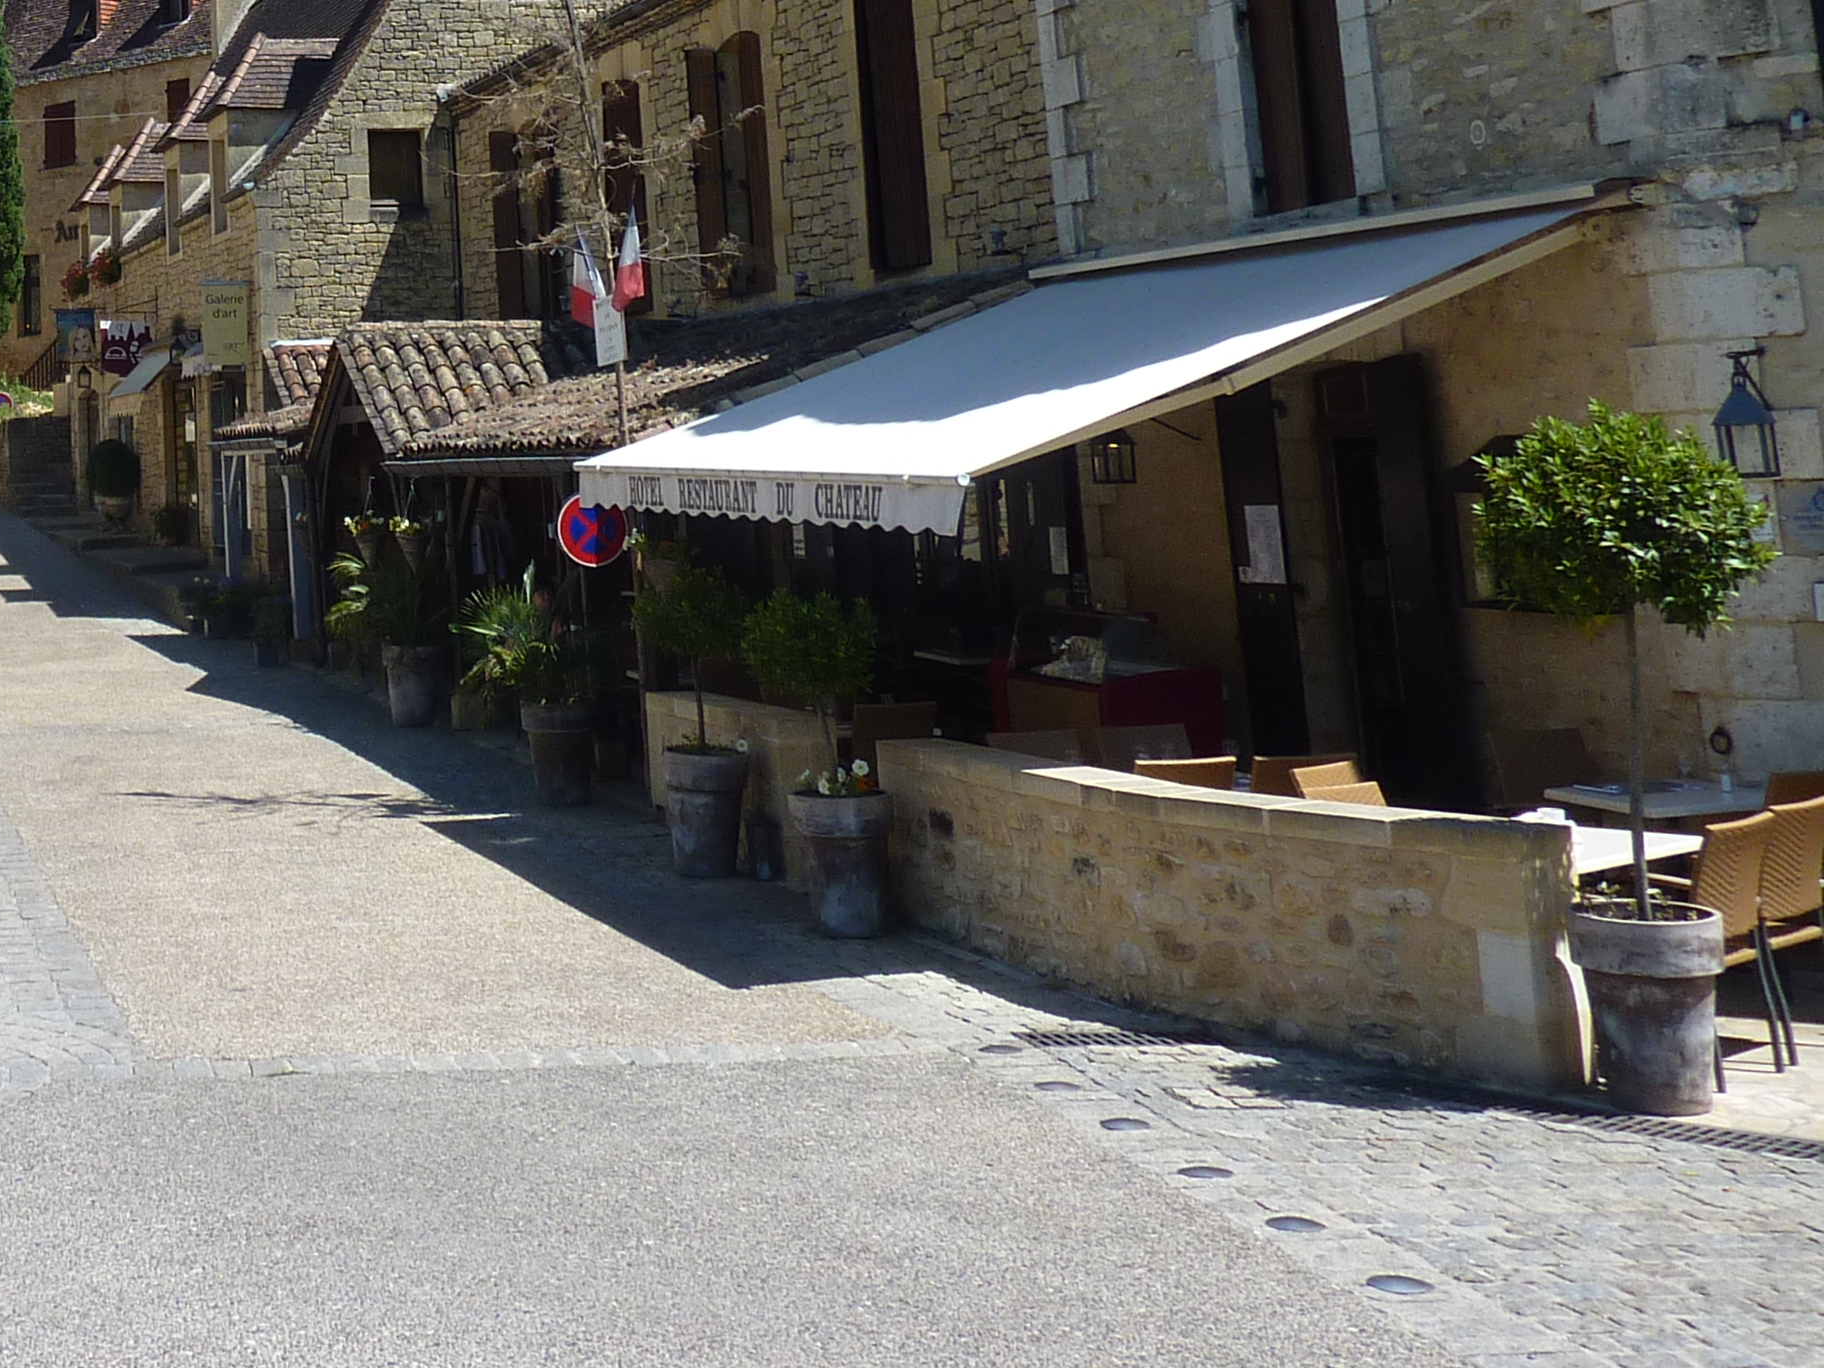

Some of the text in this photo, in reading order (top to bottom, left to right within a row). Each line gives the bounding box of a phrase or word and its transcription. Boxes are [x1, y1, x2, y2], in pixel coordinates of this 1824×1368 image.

[205, 293, 244, 305] Galerie
[212, 308, 237, 319] d'art
[678, 478, 757, 513] RESTAURANT
[776, 482, 795, 517] DU
[814, 483, 883, 522] CHATEAU
